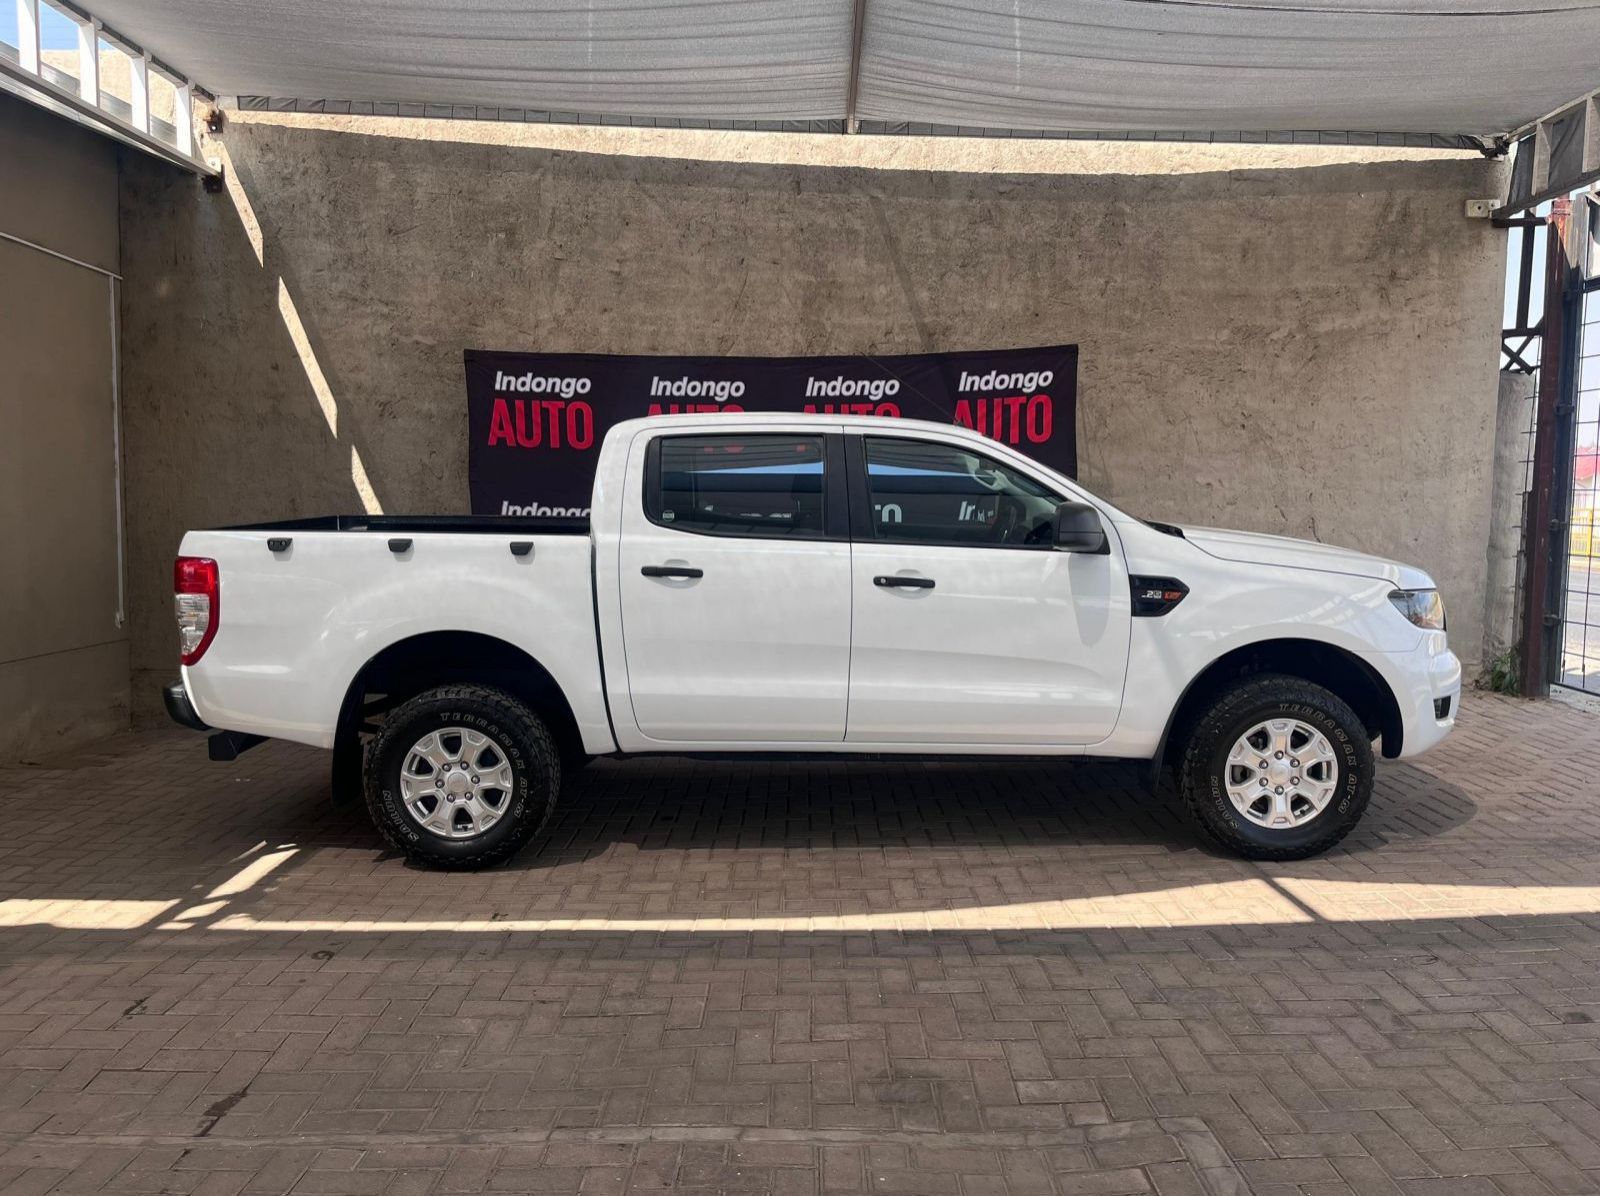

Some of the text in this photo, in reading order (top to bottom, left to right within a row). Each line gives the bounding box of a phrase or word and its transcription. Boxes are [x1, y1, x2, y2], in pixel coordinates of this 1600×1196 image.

[494, 371, 591, 398] Indongo
[650, 375, 746, 402] Indongo
[805, 375, 900, 401] Indongo
[958, 369, 1054, 394] Indongo
[488, 398, 593, 449] AUTO
[953, 394, 1053, 444] AUTO
